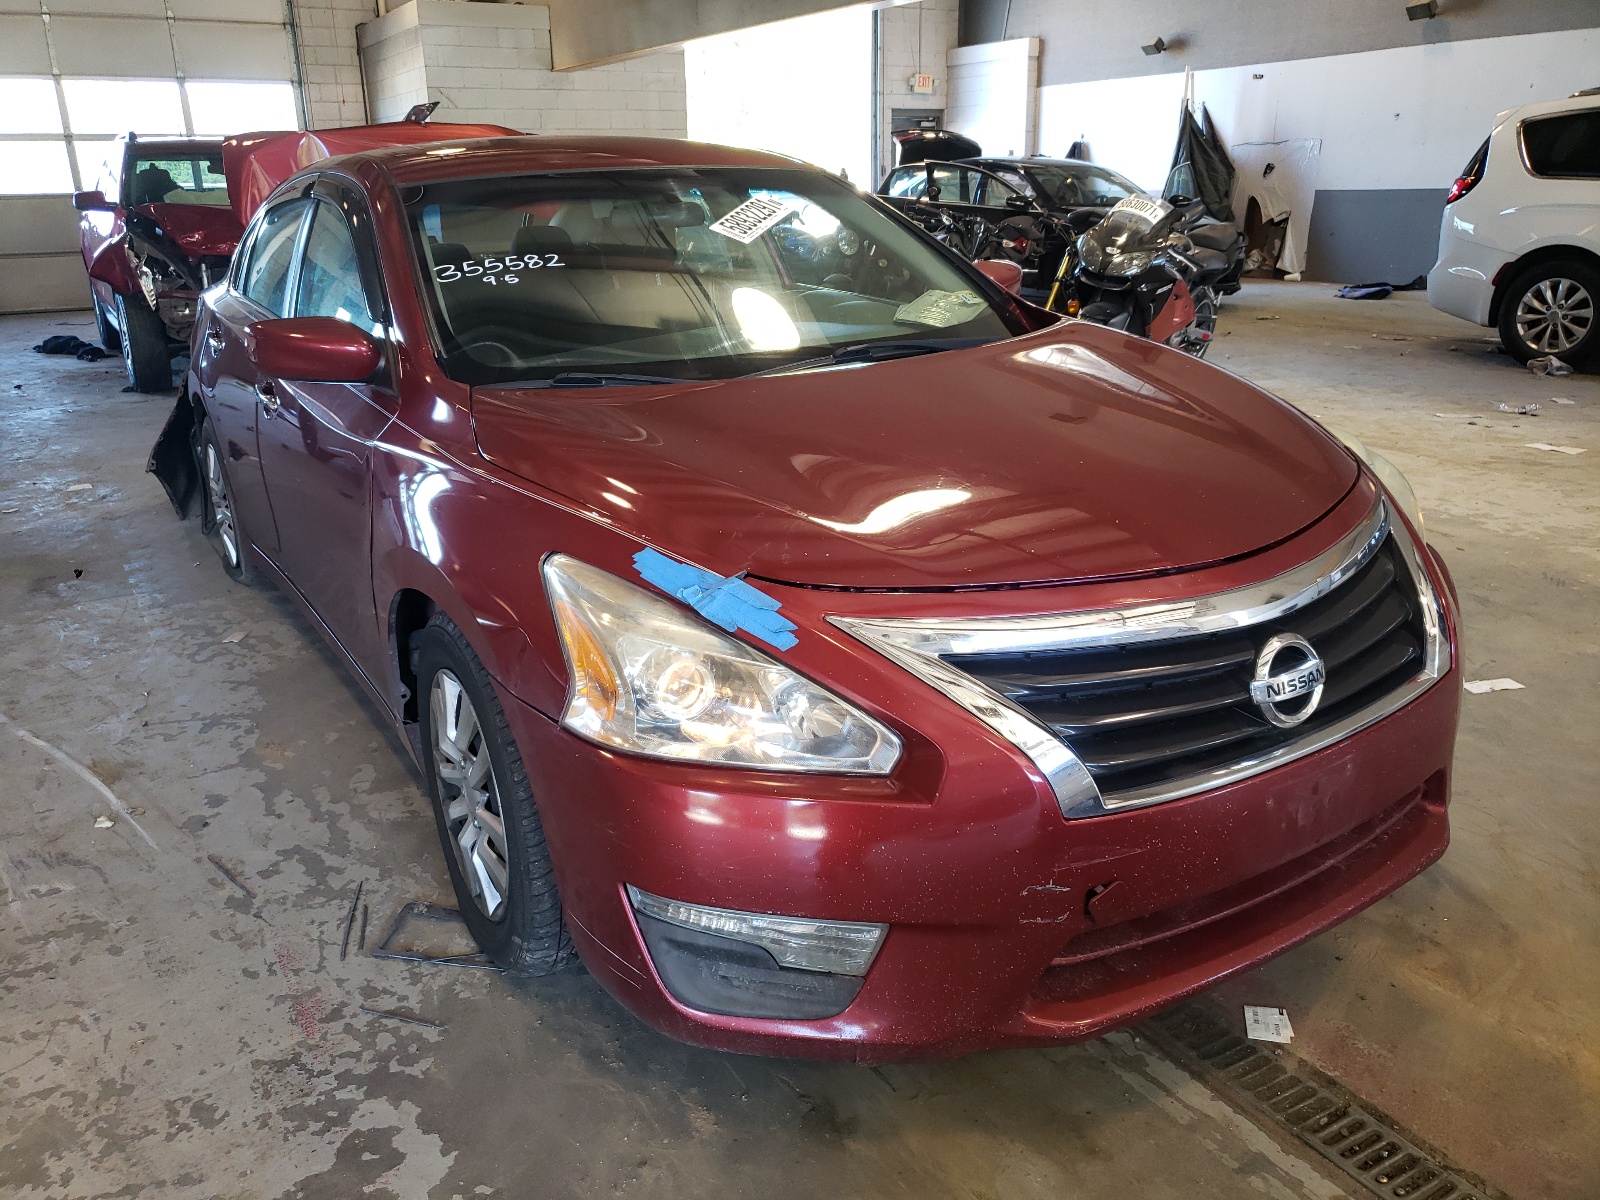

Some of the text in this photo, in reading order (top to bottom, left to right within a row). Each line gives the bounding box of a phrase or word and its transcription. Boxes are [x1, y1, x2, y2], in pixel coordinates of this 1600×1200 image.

[917, 75, 931, 88] EXIT
[718, 198, 782, 235] 58932291
[432, 253, 566, 283] 355582
[1265, 664, 1325, 699] NISSAN
